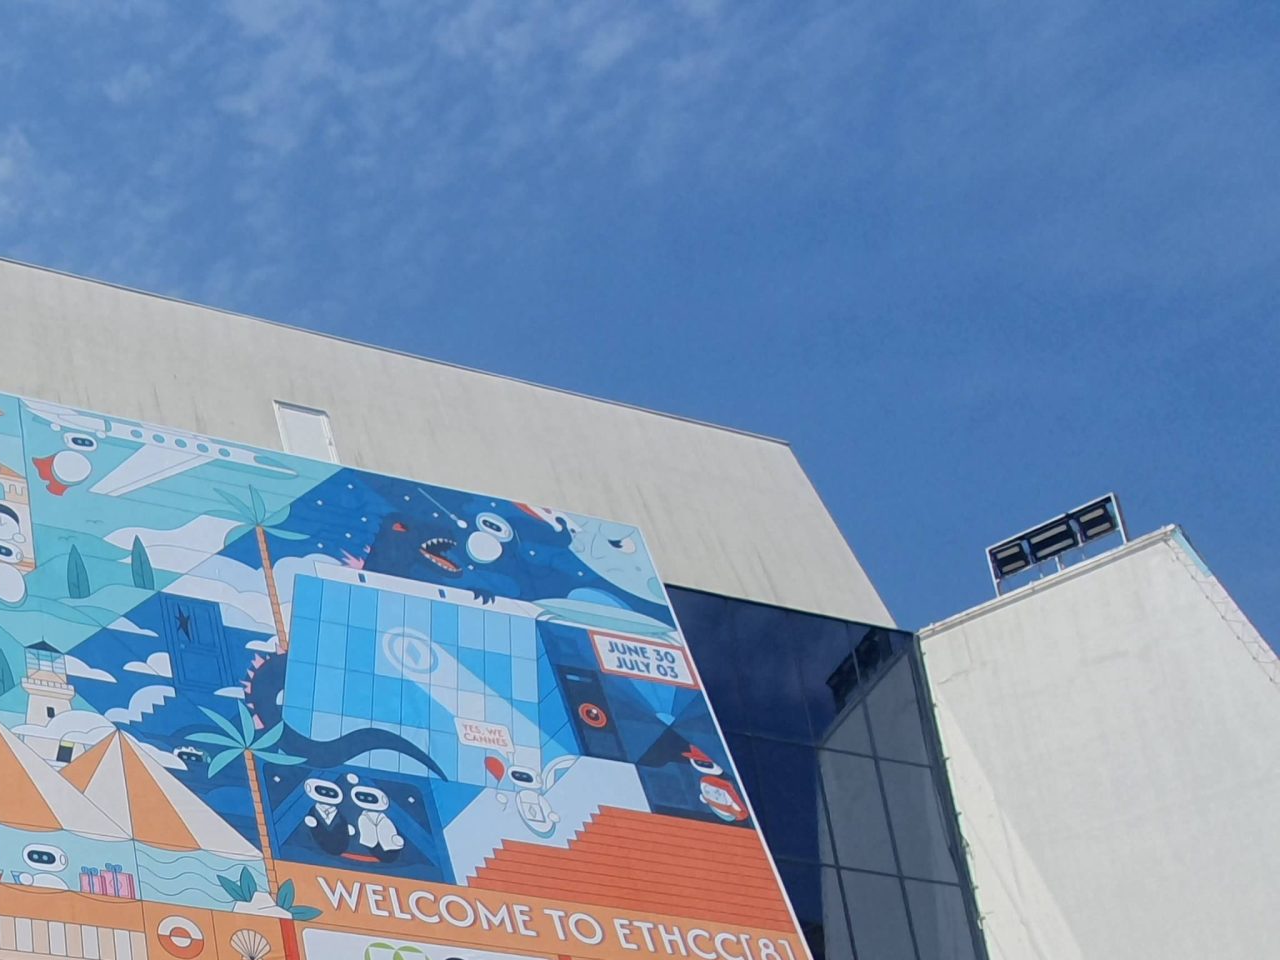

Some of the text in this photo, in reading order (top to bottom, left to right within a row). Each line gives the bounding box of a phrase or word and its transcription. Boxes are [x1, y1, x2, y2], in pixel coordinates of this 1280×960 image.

[607, 640, 676, 664] JUNE 30
[616, 656, 679, 679] JULY 03
[463, 732, 508, 747] CANNES
[487, 727, 505, 738] WE
[316, 876, 539, 938] WELCOME
[543, 906, 605, 946] TO
